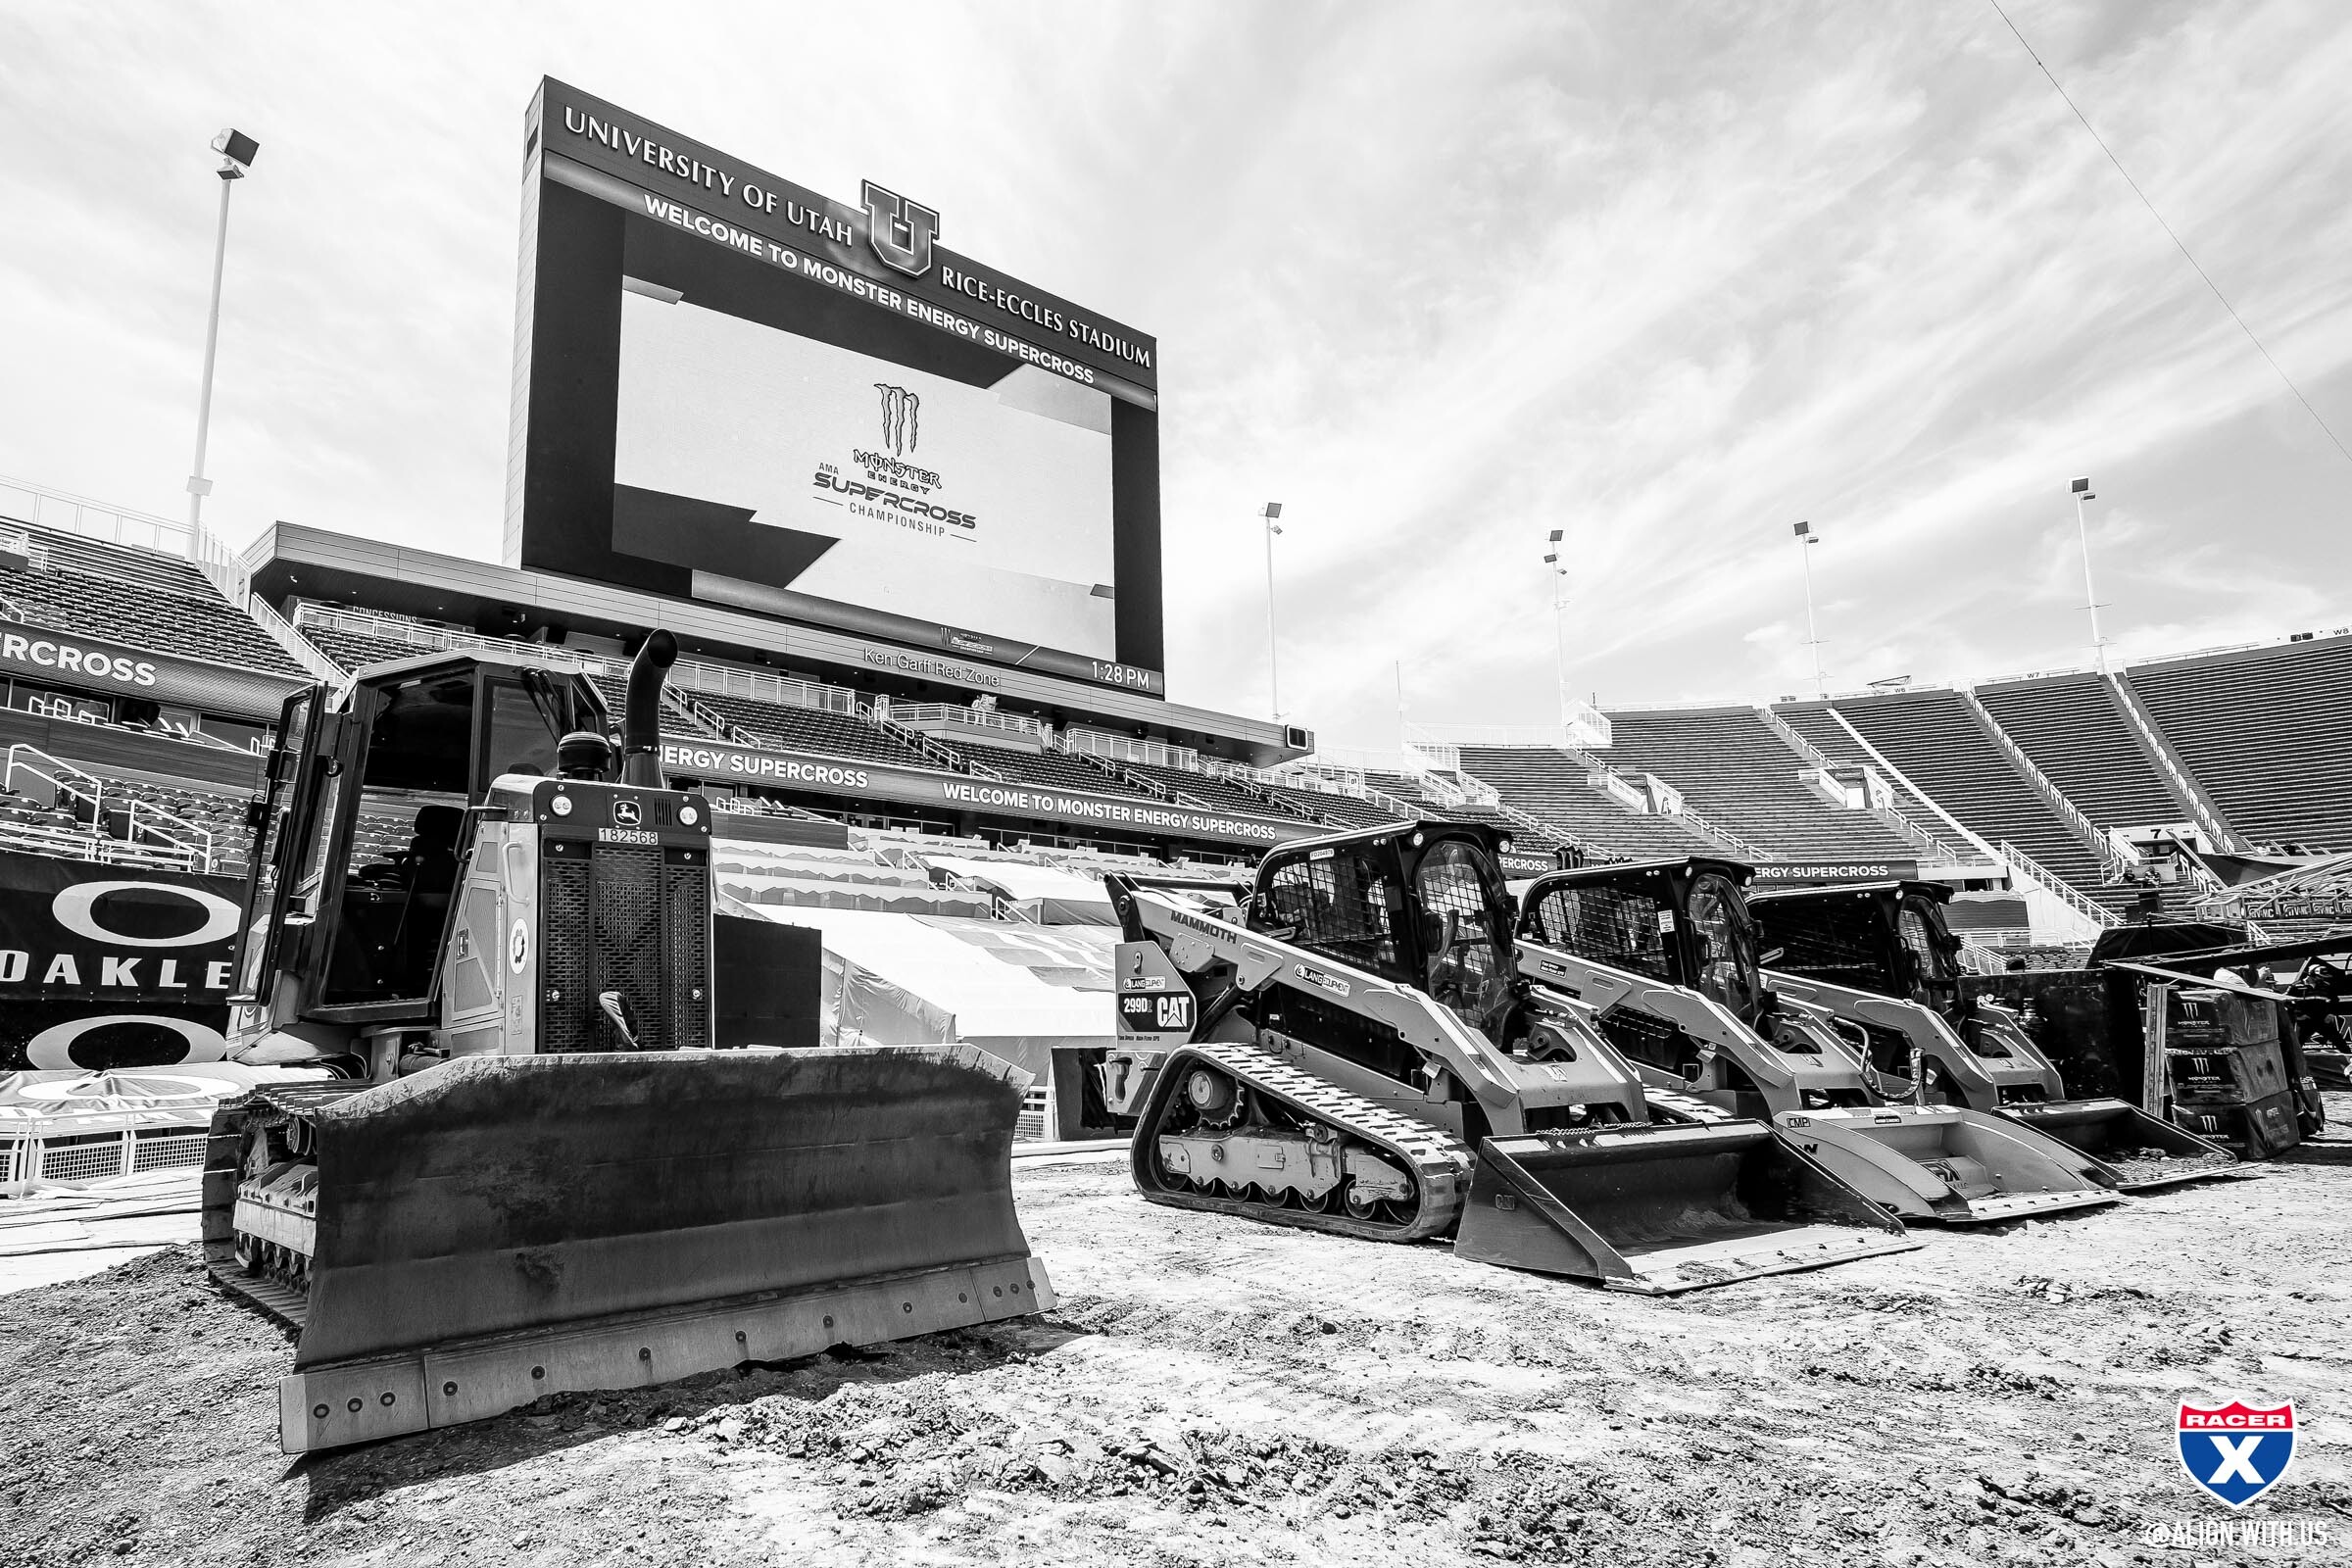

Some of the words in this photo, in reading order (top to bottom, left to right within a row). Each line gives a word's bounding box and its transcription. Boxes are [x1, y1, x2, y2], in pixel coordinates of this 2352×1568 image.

[564, 106, 735, 197] UNIVERSITY
[743, 183, 777, 214] OF
[786, 201, 854, 246] UTAH
[644, 193, 762, 257] WELCOME
[768, 242, 798, 269] TO
[803, 257, 902, 311] MONSTER
[906, 298, 980, 340] ENERGY
[984, 329, 1096, 385] SUPERCROSS
[942, 265, 1063, 333] RICE-ECCLES
[1068, 319, 1152, 368] STADIUM
[818, 462, 840, 475] AMA
[853, 449, 942, 489] MONSTER
[867, 470, 930, 495] ENERGY
[812, 471, 977, 530] SUPERCROSS
[850, 502, 946, 537] CHAMPIONSHIP
[0, 632, 157, 686] RCROSS
[863, 647, 894, 667] Ken
[897, 654, 932, 675] Garff
[936, 661, 962, 680] Red
[965, 667, 1000, 687] Zone
[1092, 661, 1123, 684] 1:28
[1126, 668, 1150, 689] PM
[729, 754, 868, 788] SUPERCROSS
[943, 782, 1029, 808] WELCOME
[1032, 794, 1054, 811] TO
[1057, 798, 1131, 821] MONSTER
[1134, 808, 1190, 829] ENERGY
[1192, 815, 1277, 841] SUPERCROSS
[600, 828, 658, 845] 182568
[2150, 829, 2162, 840] 7
[1791, 865, 1889, 878] SUPERCROSS
[1170, 909, 1237, 944] MAMMOTH
[0, 950, 233, 989] OAKLE
[1304, 969, 1323, 984] LANG
[1157, 996, 1190, 1027] CAT
